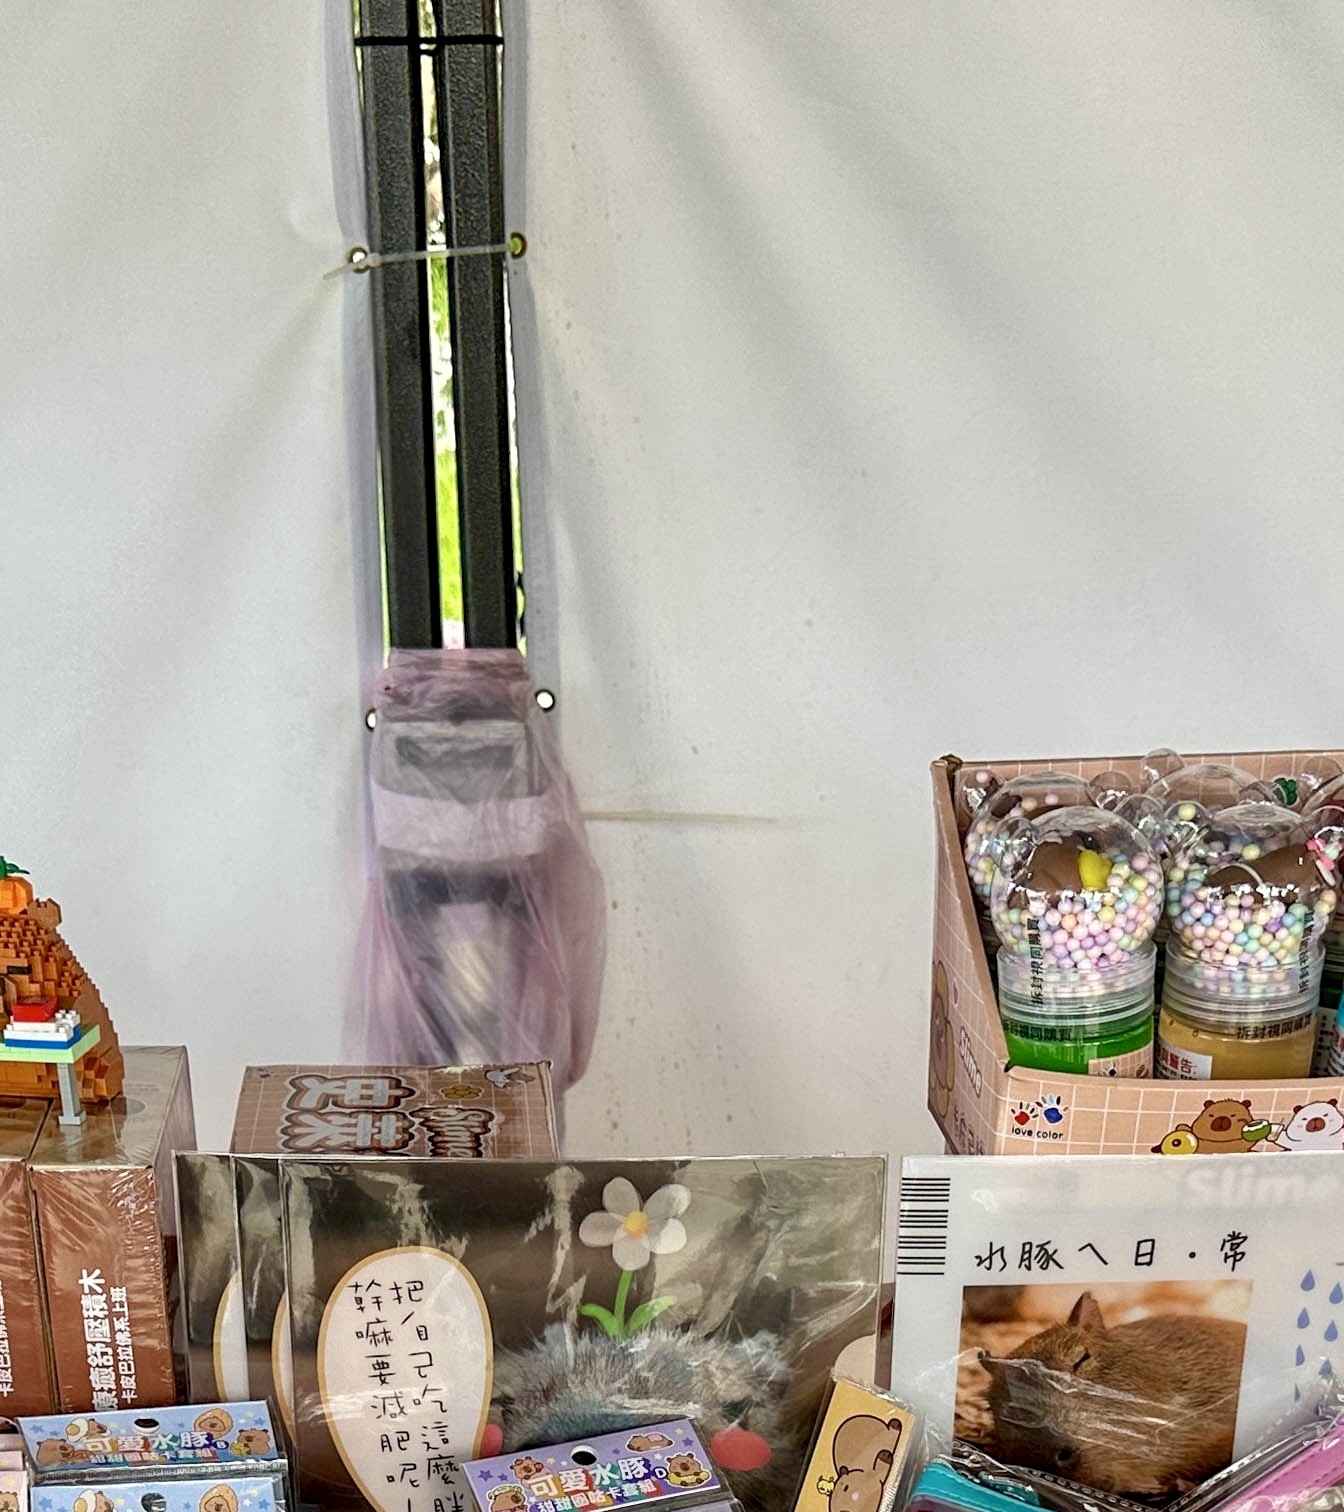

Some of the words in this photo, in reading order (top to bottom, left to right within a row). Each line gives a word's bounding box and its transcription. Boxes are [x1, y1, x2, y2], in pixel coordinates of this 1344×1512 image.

[1011, 1126, 1033, 1137] love
[1036, 1130, 1064, 1140] color
[85, 1432, 210, 1453] 可愛水豚
[529, 1456, 650, 1498] 可愛水豚
